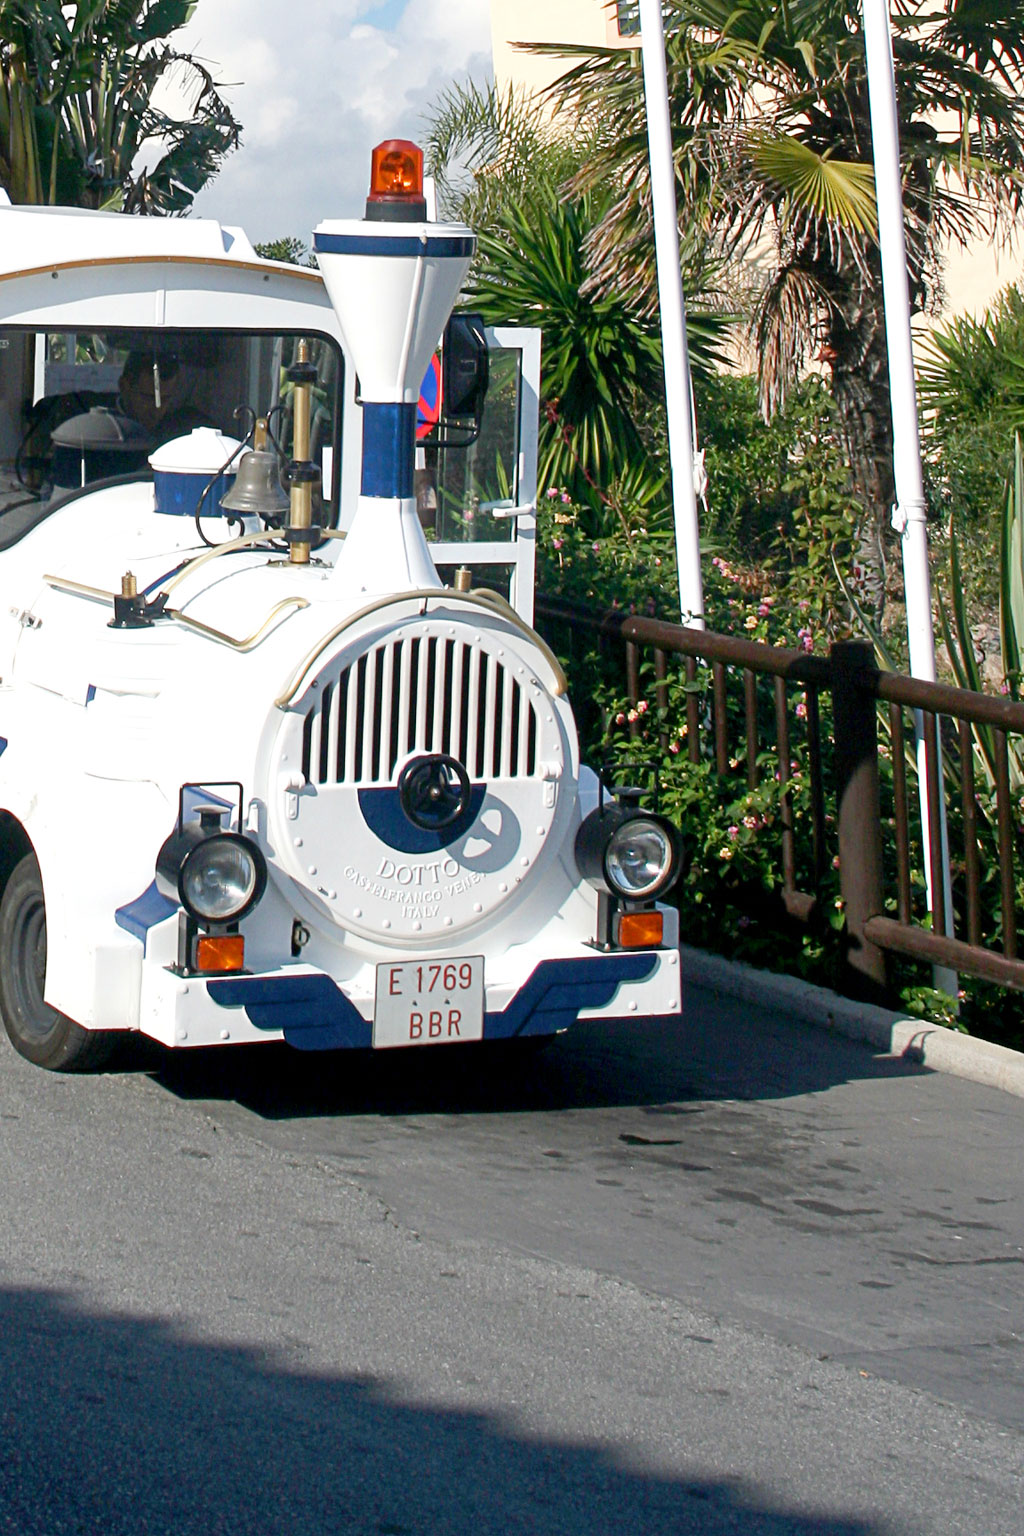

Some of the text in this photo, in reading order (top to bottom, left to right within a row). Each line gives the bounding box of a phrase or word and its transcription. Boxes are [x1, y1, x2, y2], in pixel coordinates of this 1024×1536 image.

[343, 865, 487, 904] CASTELFRANCO VENE
[376, 856, 460, 885] DOTTO
[401, 905, 440, 919] ITALY
[389, 962, 471, 995] E 1769
[409, 1009, 461, 1040] BBR
